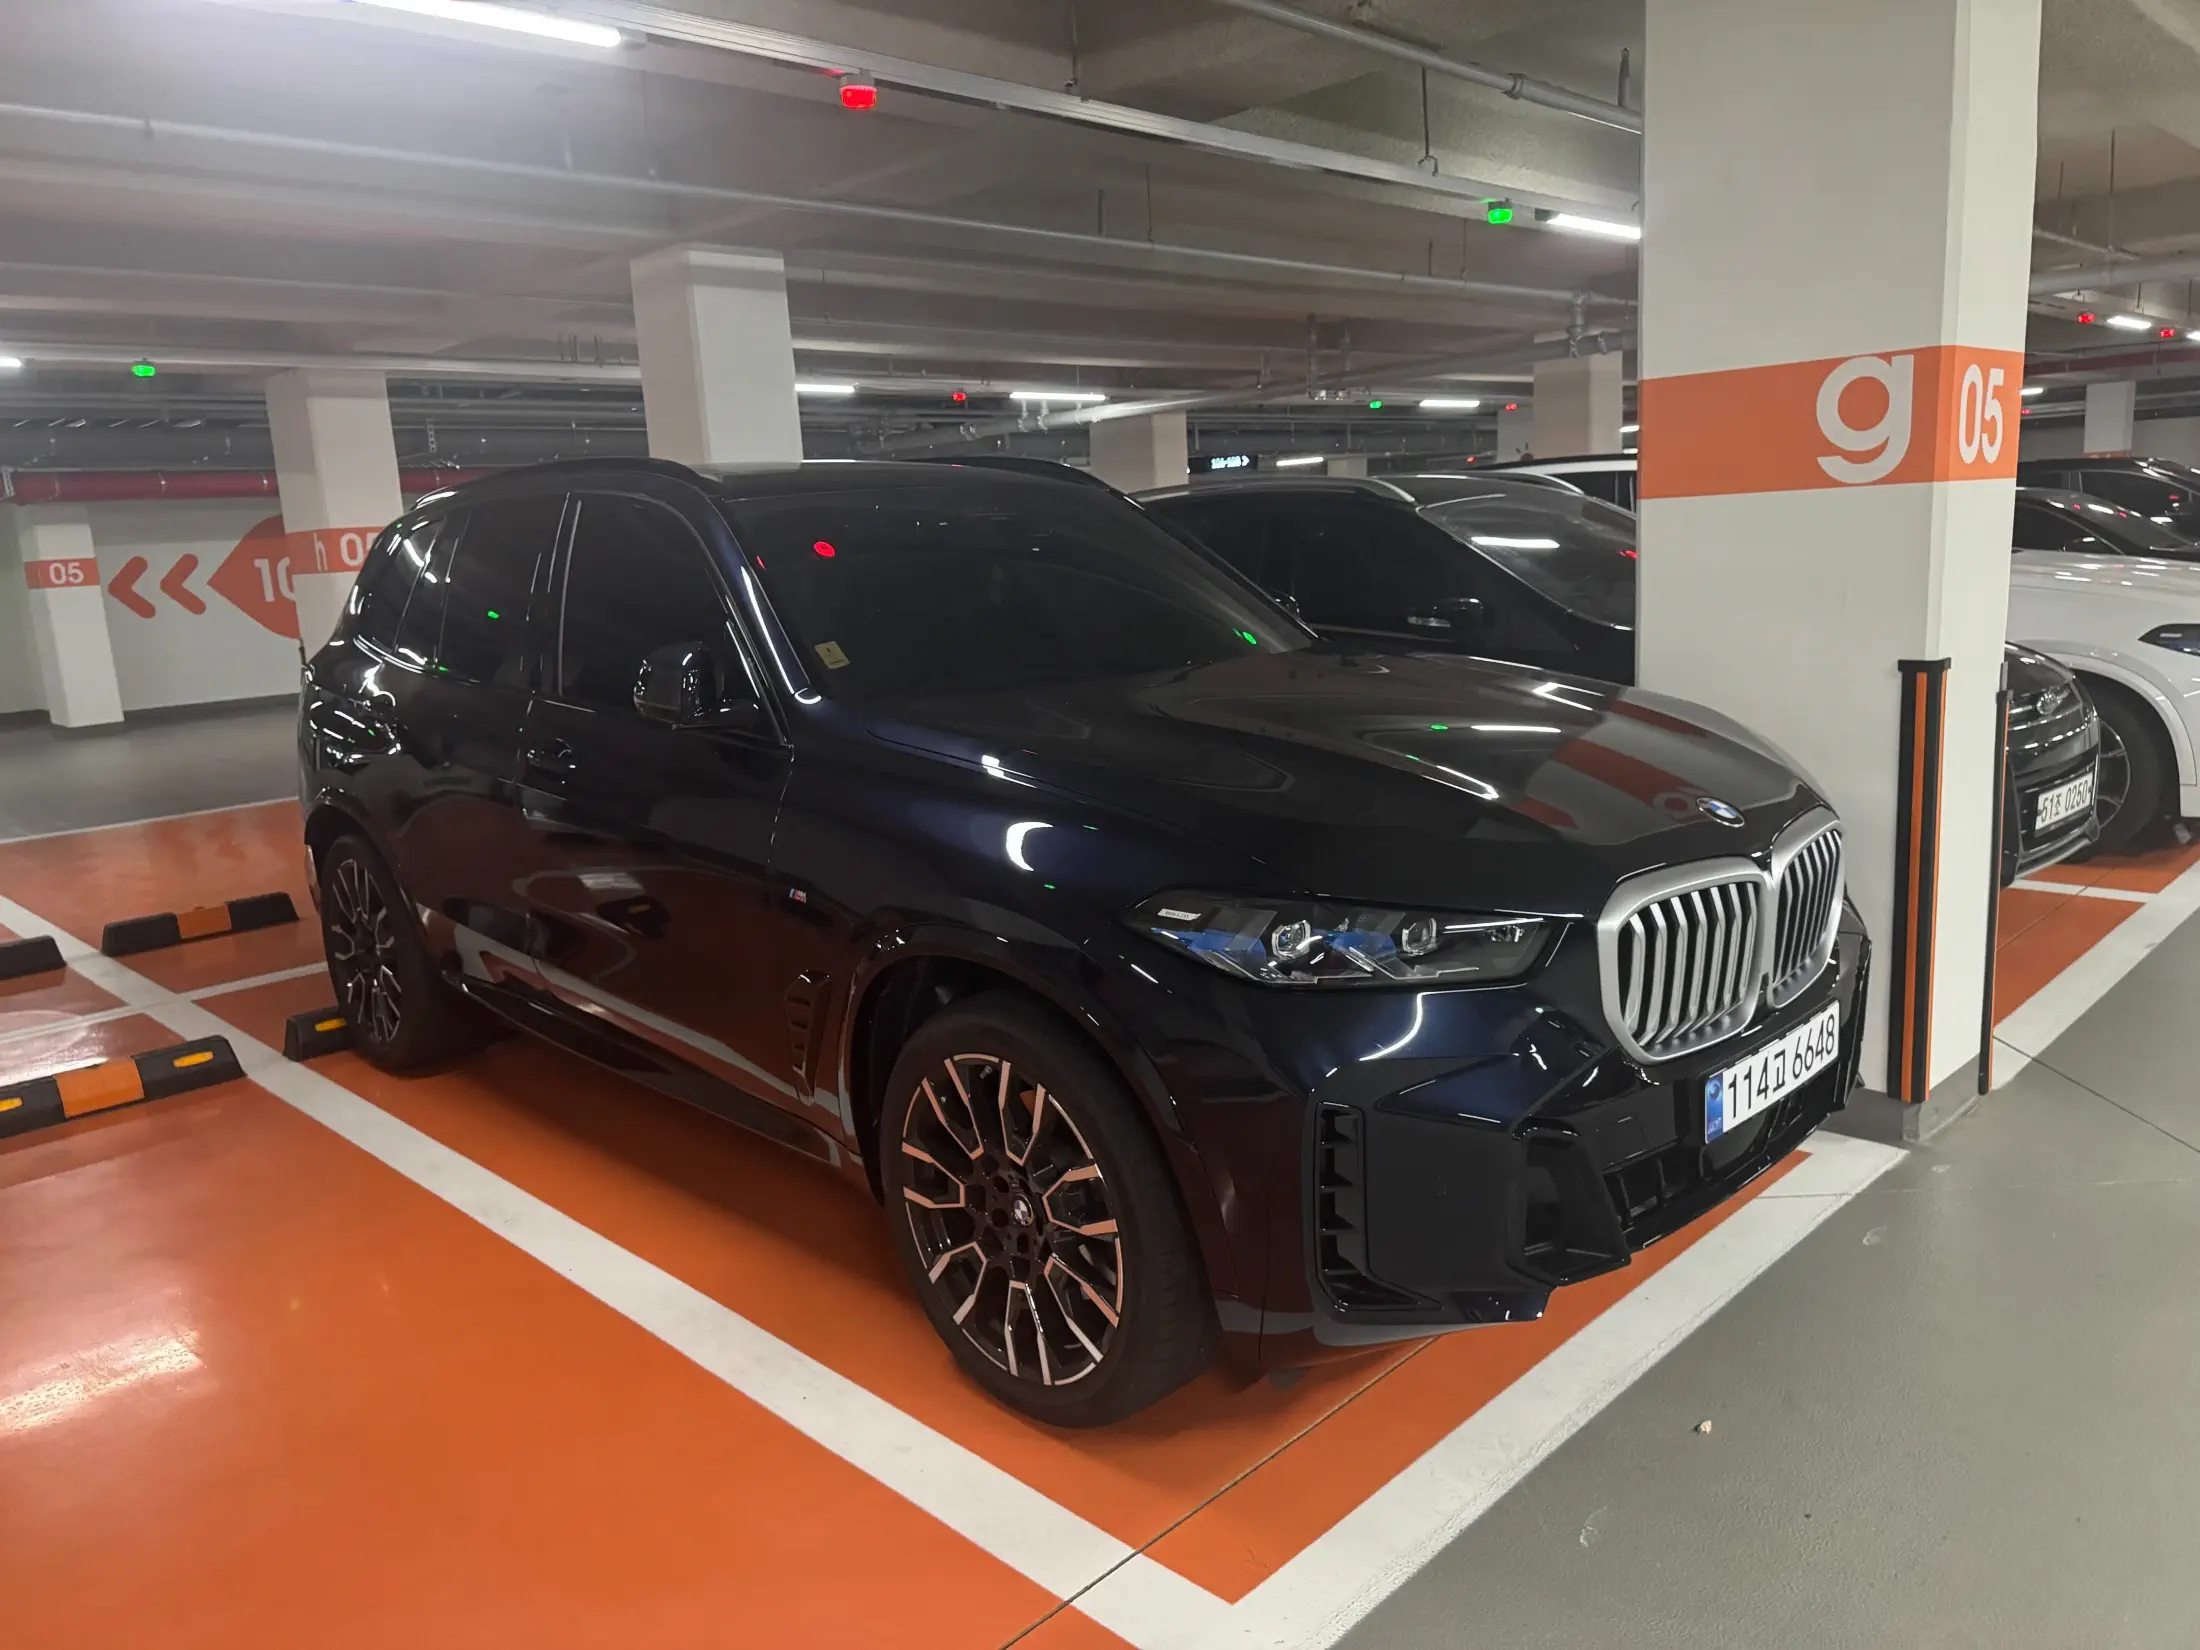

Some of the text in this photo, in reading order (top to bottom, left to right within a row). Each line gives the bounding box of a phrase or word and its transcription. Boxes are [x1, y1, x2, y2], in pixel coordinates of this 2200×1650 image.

[1816, 354, 2004, 484] g 05
[313, 532, 328, 572] h
[49, 562, 84, 585] 05
[2065, 779, 2088, 812] 0250
[1728, 1013, 1836, 1119] 114고 6648
